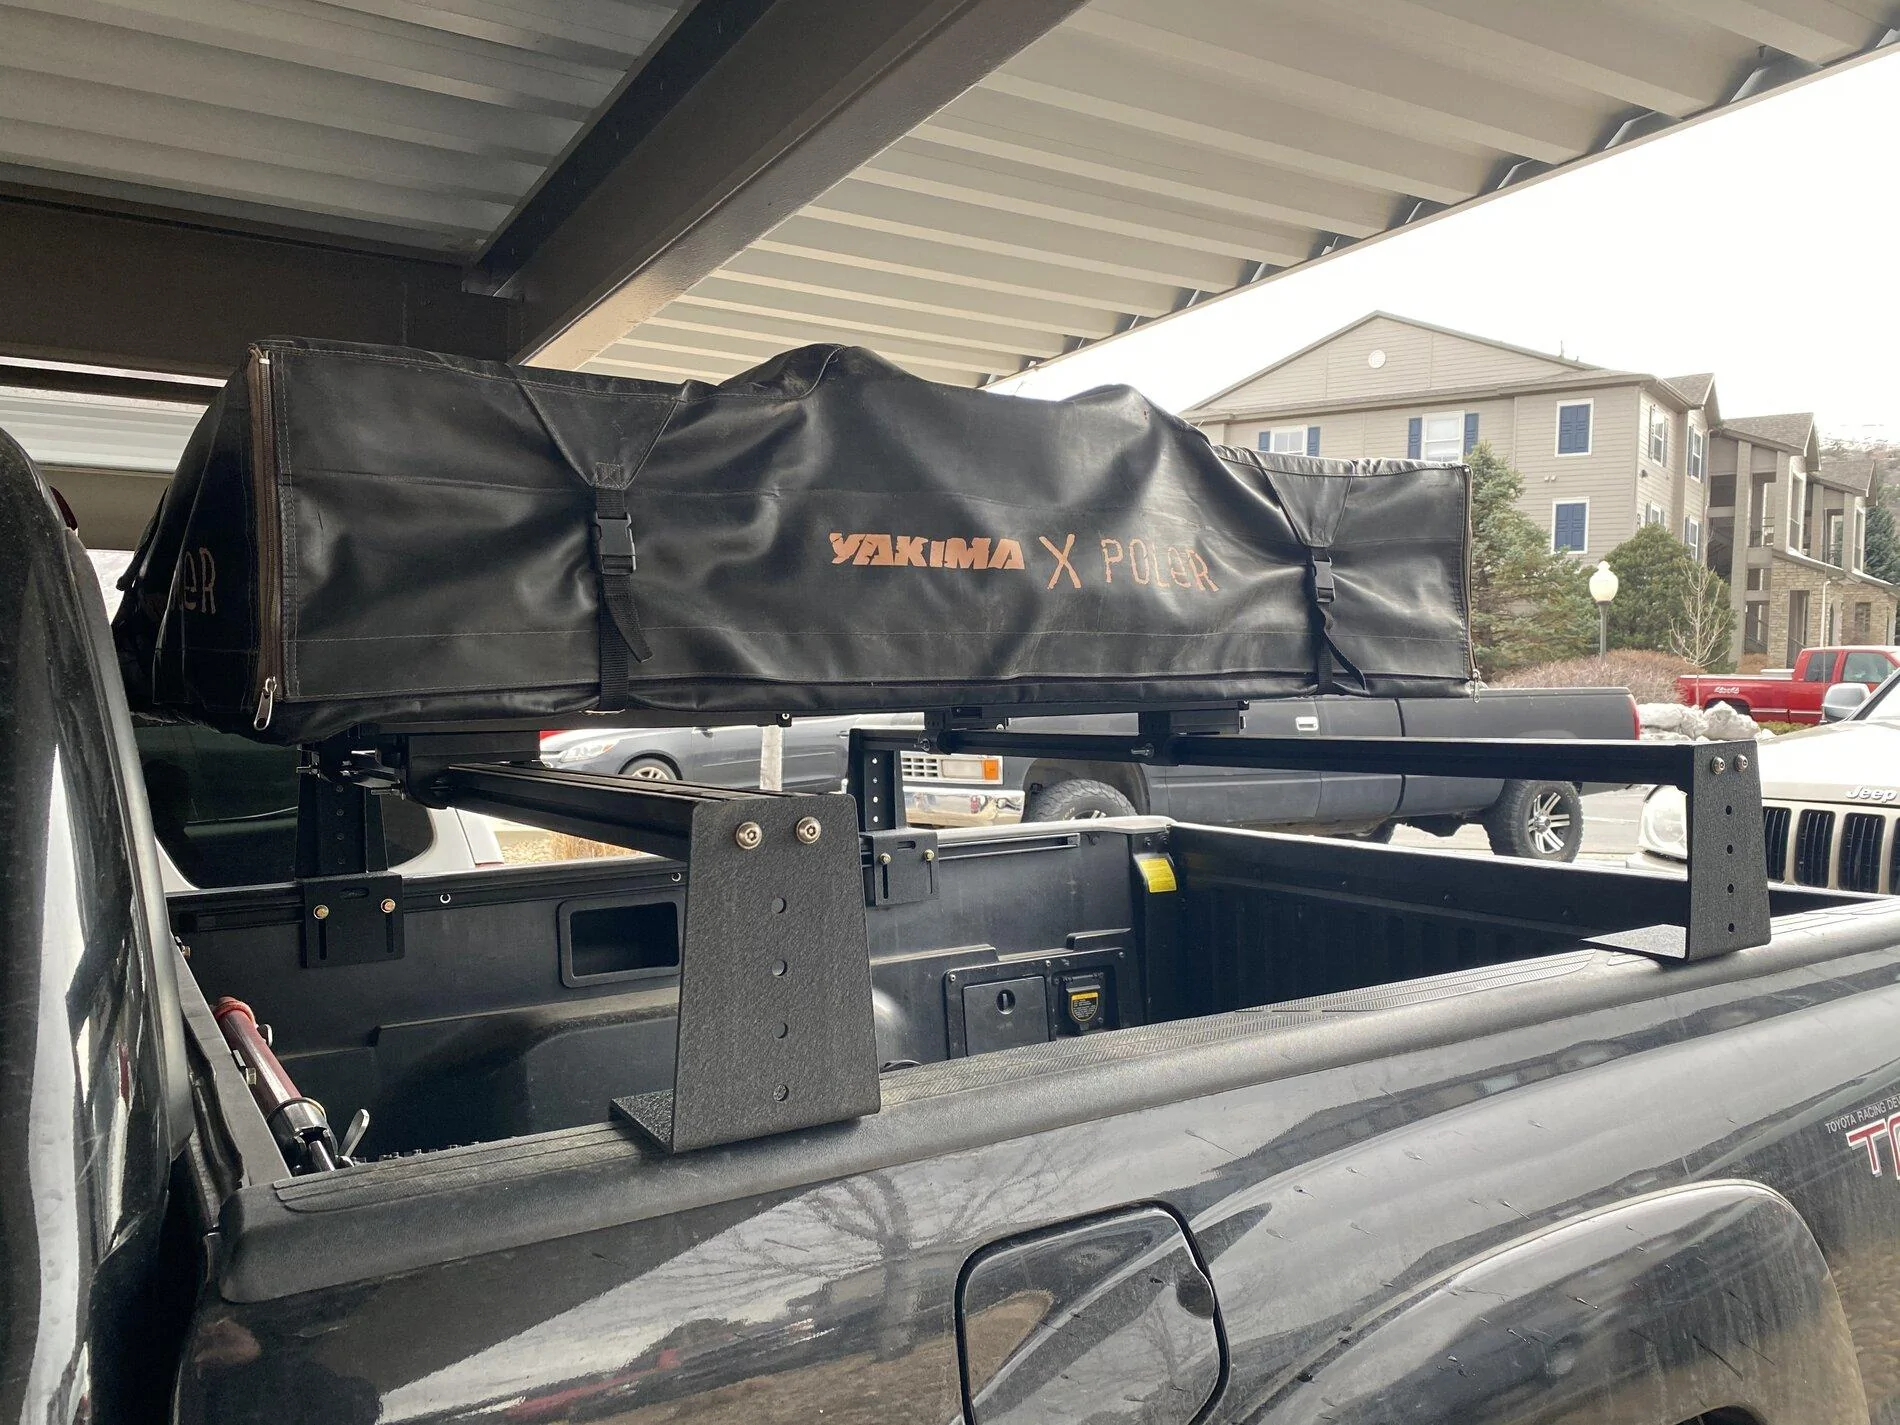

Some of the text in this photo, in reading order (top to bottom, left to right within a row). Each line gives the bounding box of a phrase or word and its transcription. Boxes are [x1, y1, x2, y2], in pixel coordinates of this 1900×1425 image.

[829, 532, 1025, 570] YAKIMA
[1039, 534, 1081, 589] X
[1845, 784, 1898, 804] Jeep
[1825, 1114, 1857, 1134] TOYOTA
[1856, 1101, 1887, 1122] RACING
